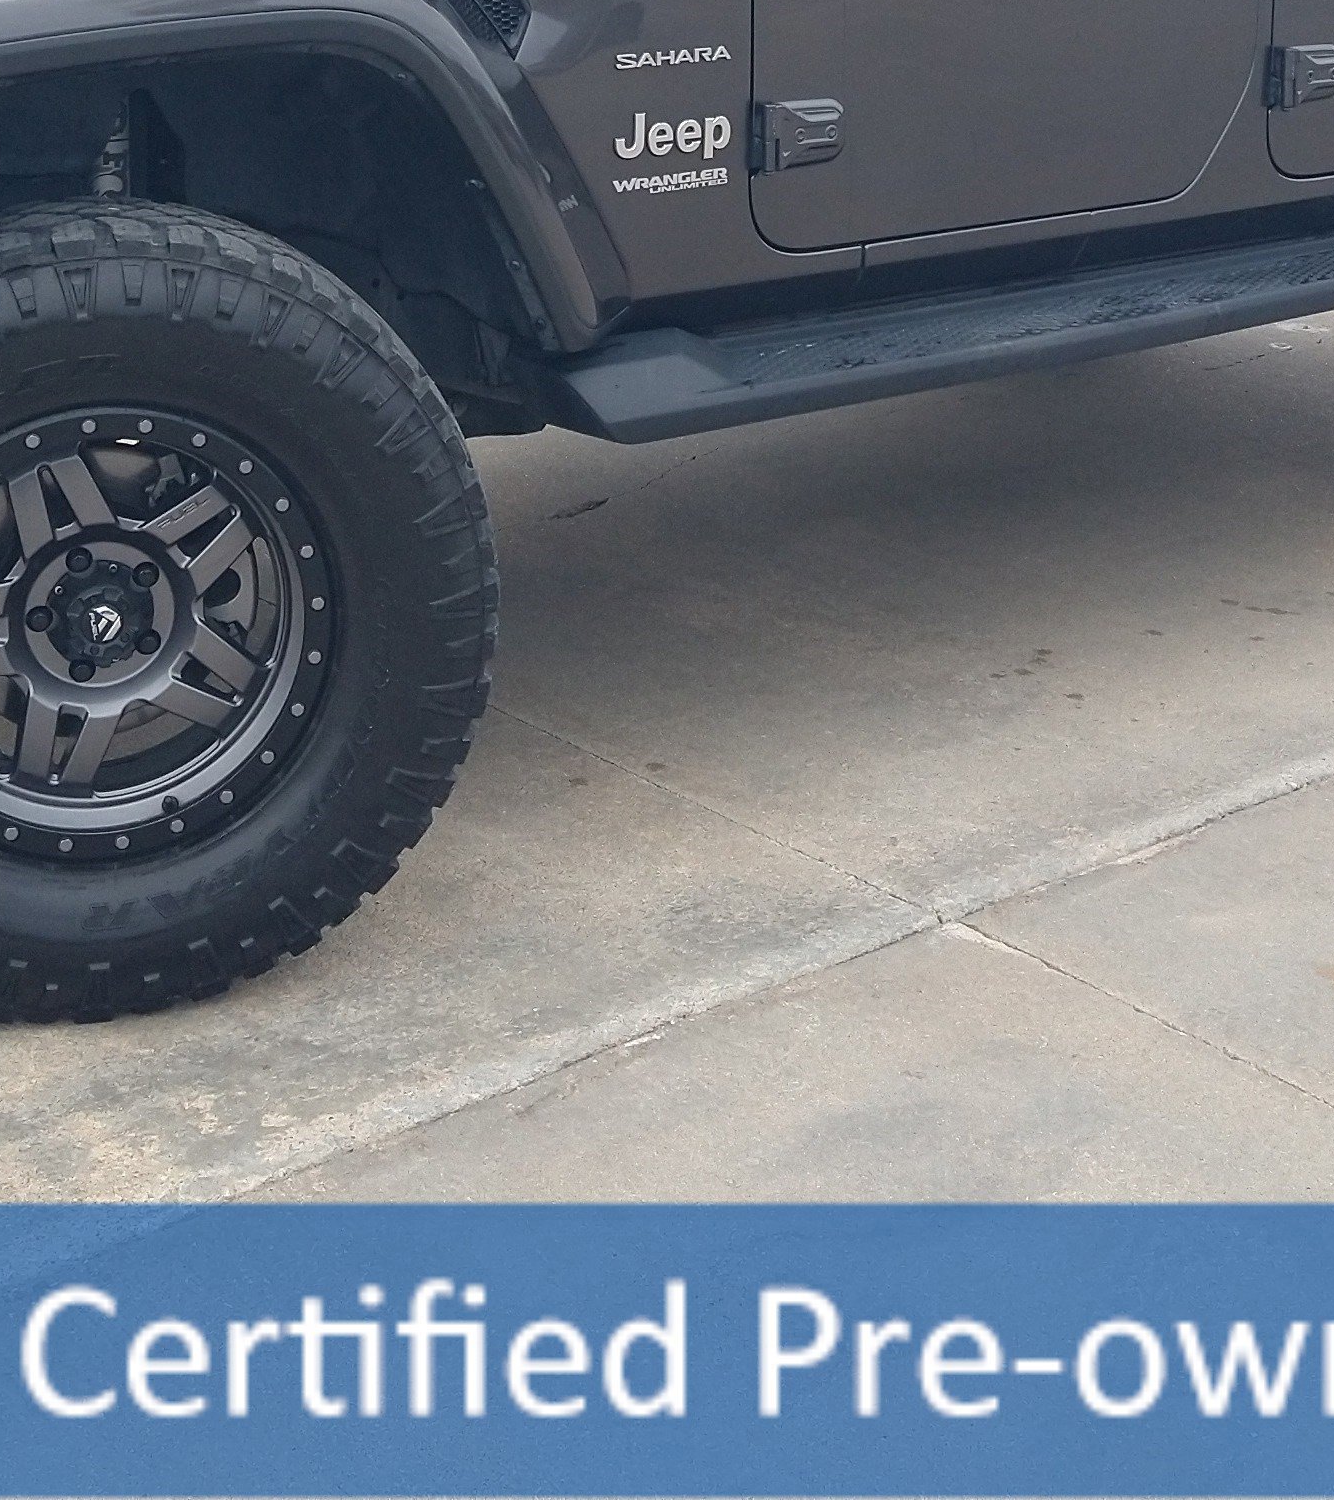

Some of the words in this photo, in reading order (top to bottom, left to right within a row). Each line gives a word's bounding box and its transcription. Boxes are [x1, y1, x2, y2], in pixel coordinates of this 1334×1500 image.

[615, 45, 732, 70] SAHARA
[615, 112, 732, 160] Jeep
[612, 167, 729, 193] WRANGLER
[649, 178, 729, 195] UNLIMITED
